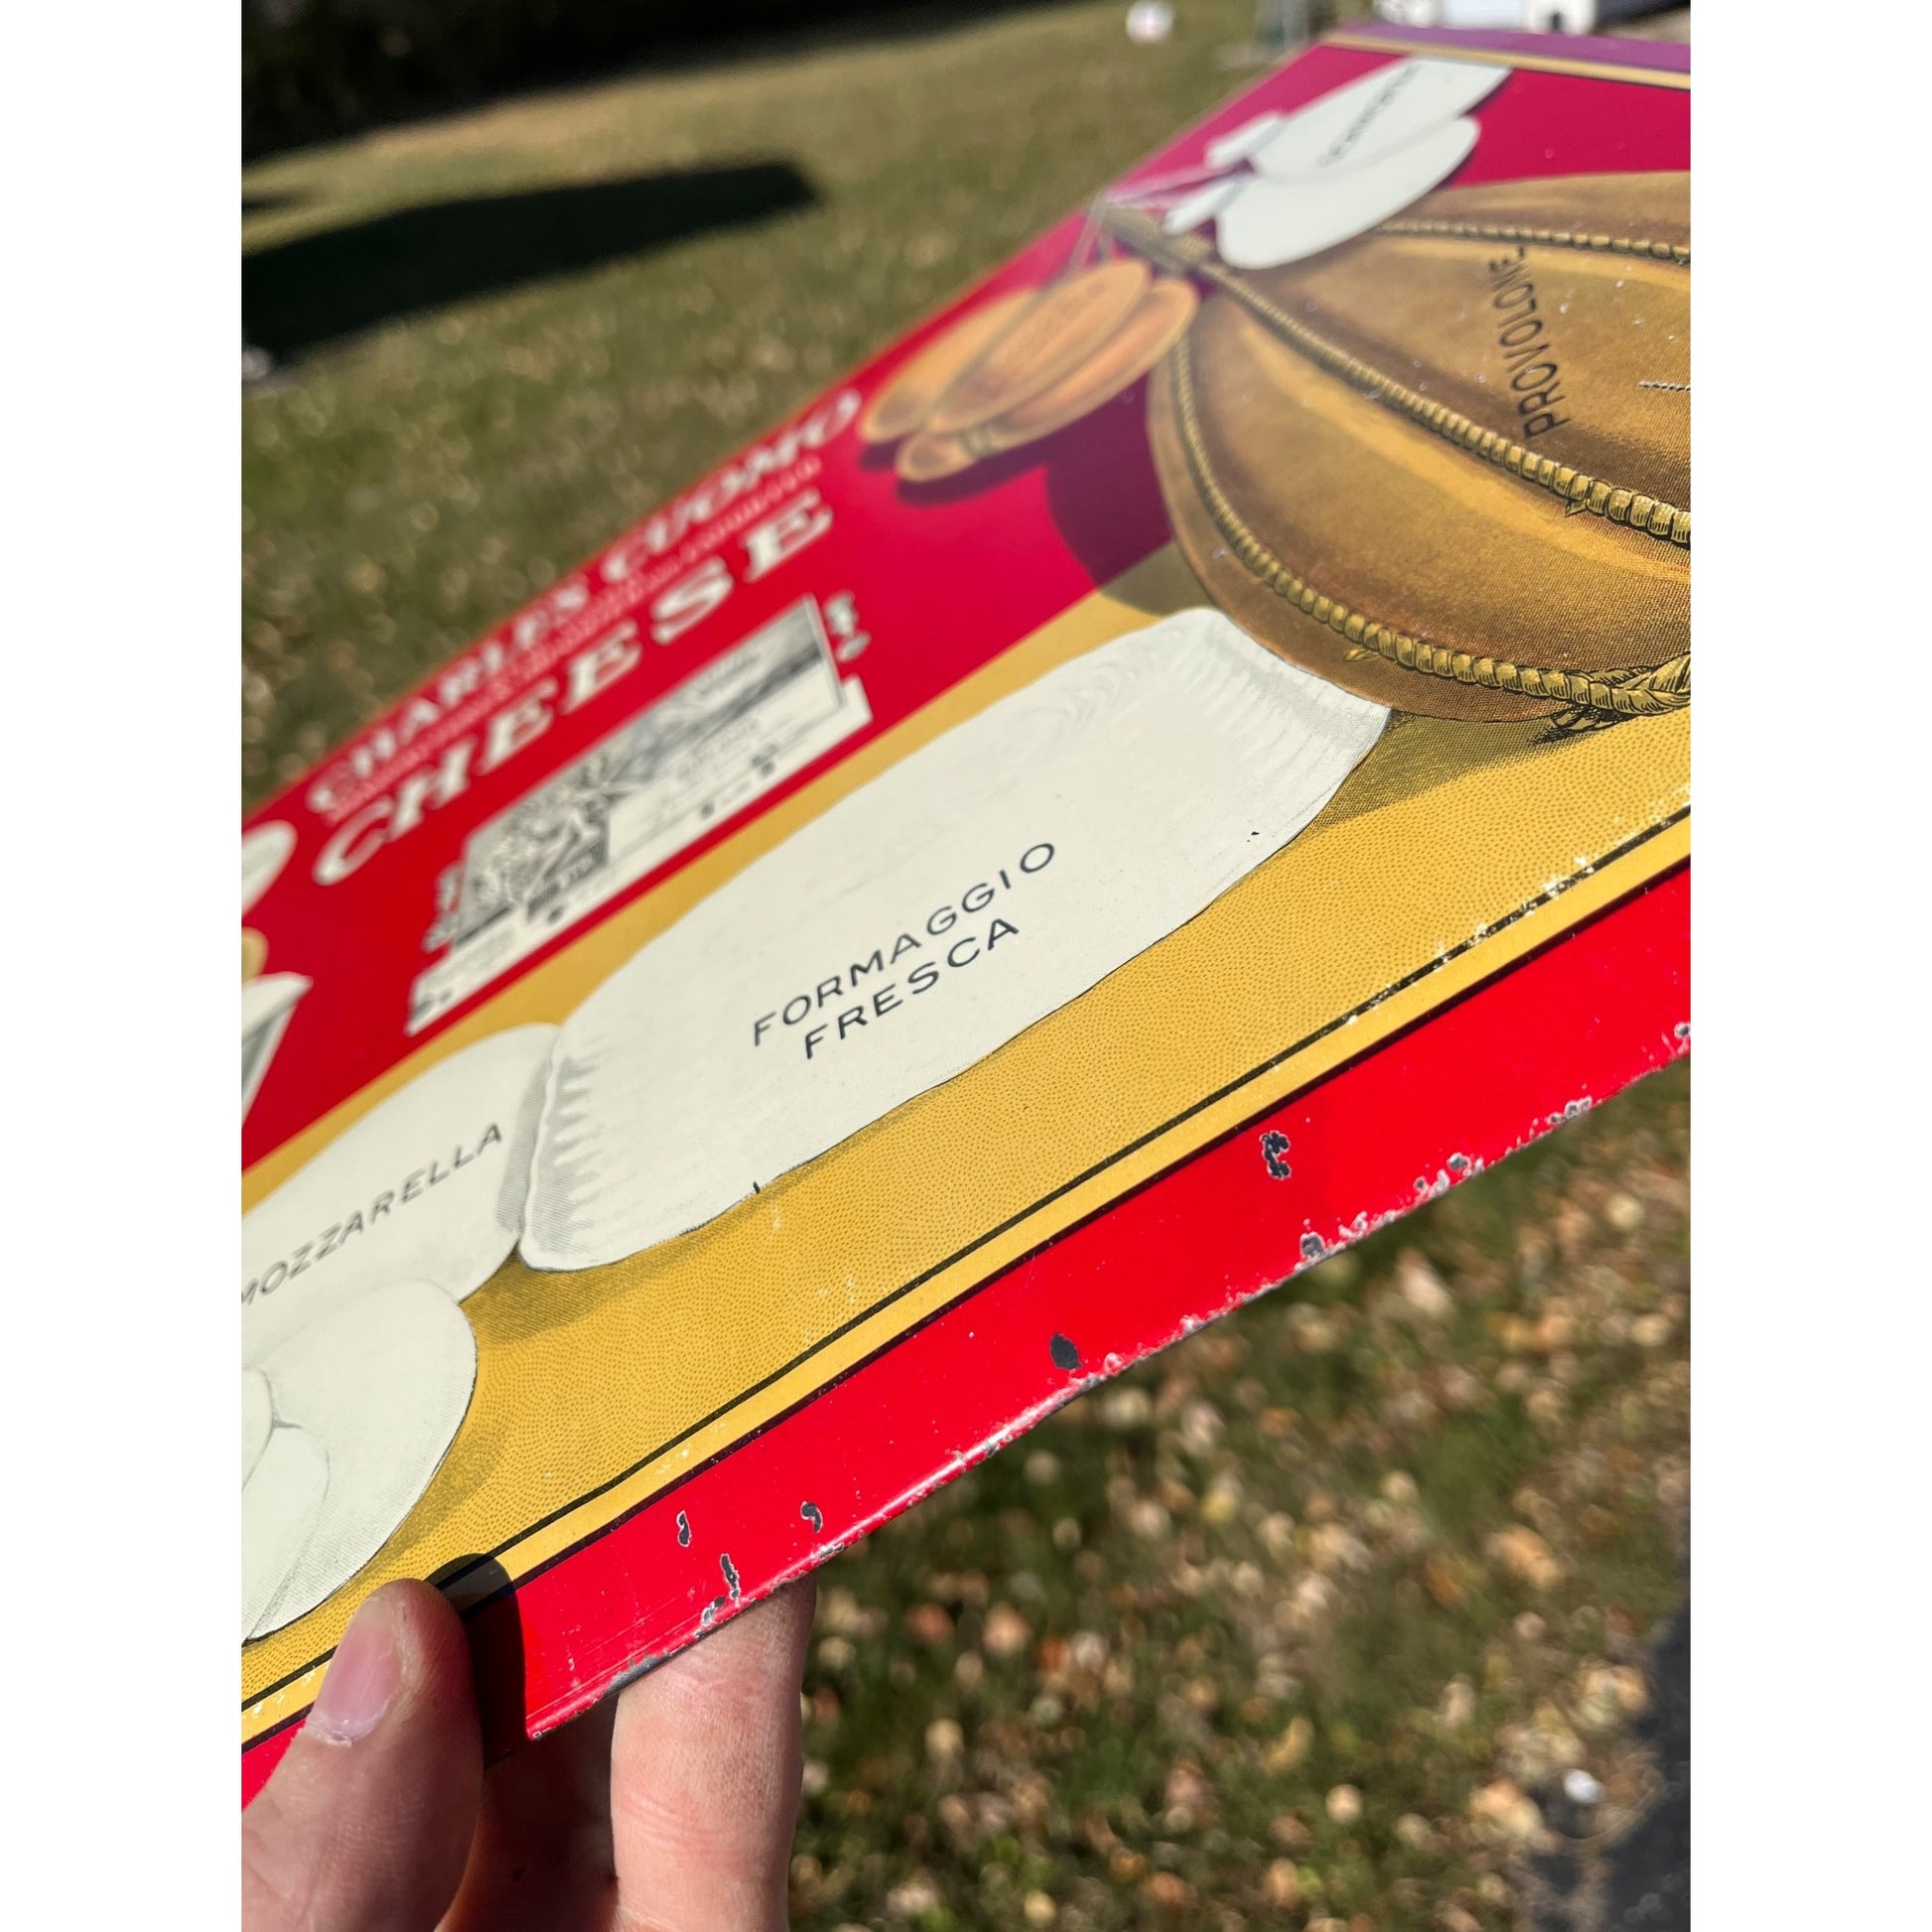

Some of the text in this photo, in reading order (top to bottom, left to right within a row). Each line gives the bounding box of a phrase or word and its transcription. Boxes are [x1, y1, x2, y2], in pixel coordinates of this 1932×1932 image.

[1488, 246, 1571, 440] PROVOLONE
[313, 486, 835, 887] CHEESE
[754, 843, 1055, 1046] FORMAGGIO
[804, 917, 1020, 1059] FRESCA
[241, 1122, 502, 1306] MOZZARELLA
